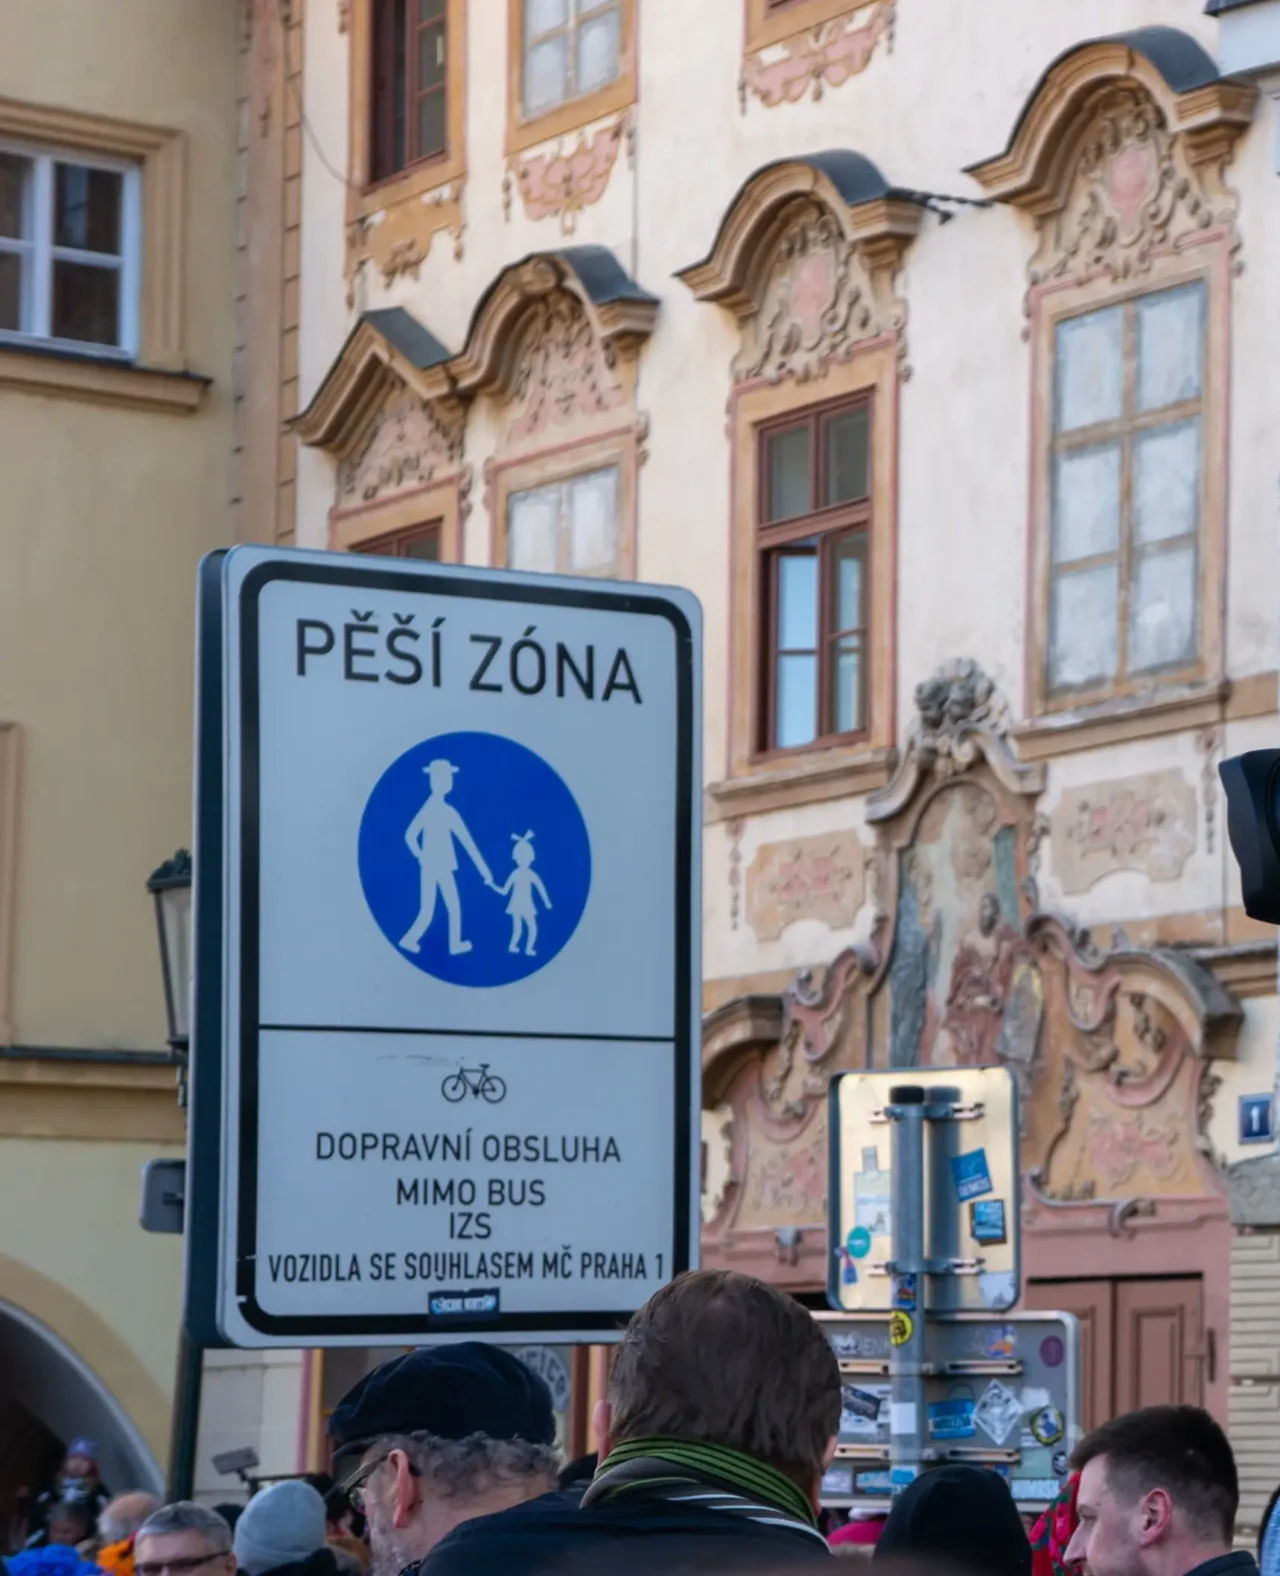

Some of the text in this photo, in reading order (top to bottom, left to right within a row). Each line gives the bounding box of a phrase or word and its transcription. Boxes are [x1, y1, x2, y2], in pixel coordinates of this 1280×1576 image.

[296, 609, 644, 704] PĚŠÍ ZÓNA
[1251, 1105, 1260, 1132] 1
[316, 1127, 621, 1163] DOPRAVNÍ OBSLUHA
[396, 1178, 546, 1206] MIMO BUS
[449, 1212, 492, 1240] IZS
[268, 1245, 664, 1282] VOZIDLA SE SOUHLASEM MČ PRAHA 1
